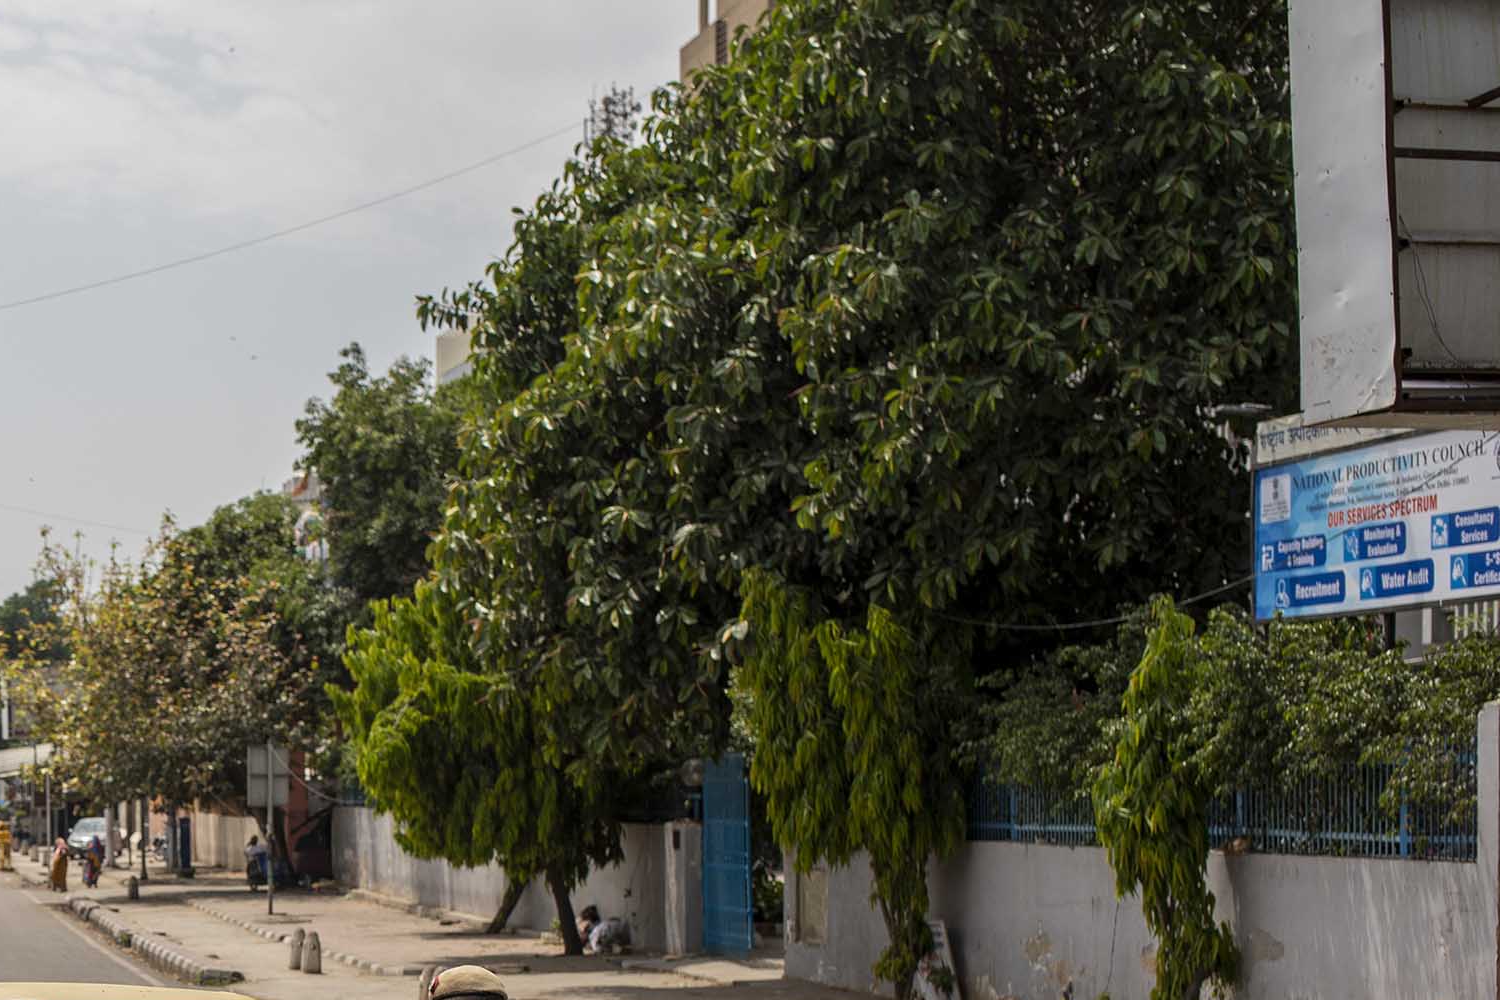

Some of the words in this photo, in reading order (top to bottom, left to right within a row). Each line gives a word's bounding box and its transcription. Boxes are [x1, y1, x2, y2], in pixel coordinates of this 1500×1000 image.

[1292, 468, 1343, 489] NATIONAL
[1346, 449, 1430, 481] PRODUCTIVITY
[1327, 511, 1345, 528] OUR
[1347, 503, 1387, 525] SERVICES
[1389, 494, 1438, 519] SPECTRUM
[1455, 512, 1495, 528] Consultancy
[1461, 530, 1488, 544] Services
[1295, 579, 1341, 600] Recruitment
[1381, 571, 1406, 590] Water
[1407, 567, 1430, 586] Audit
